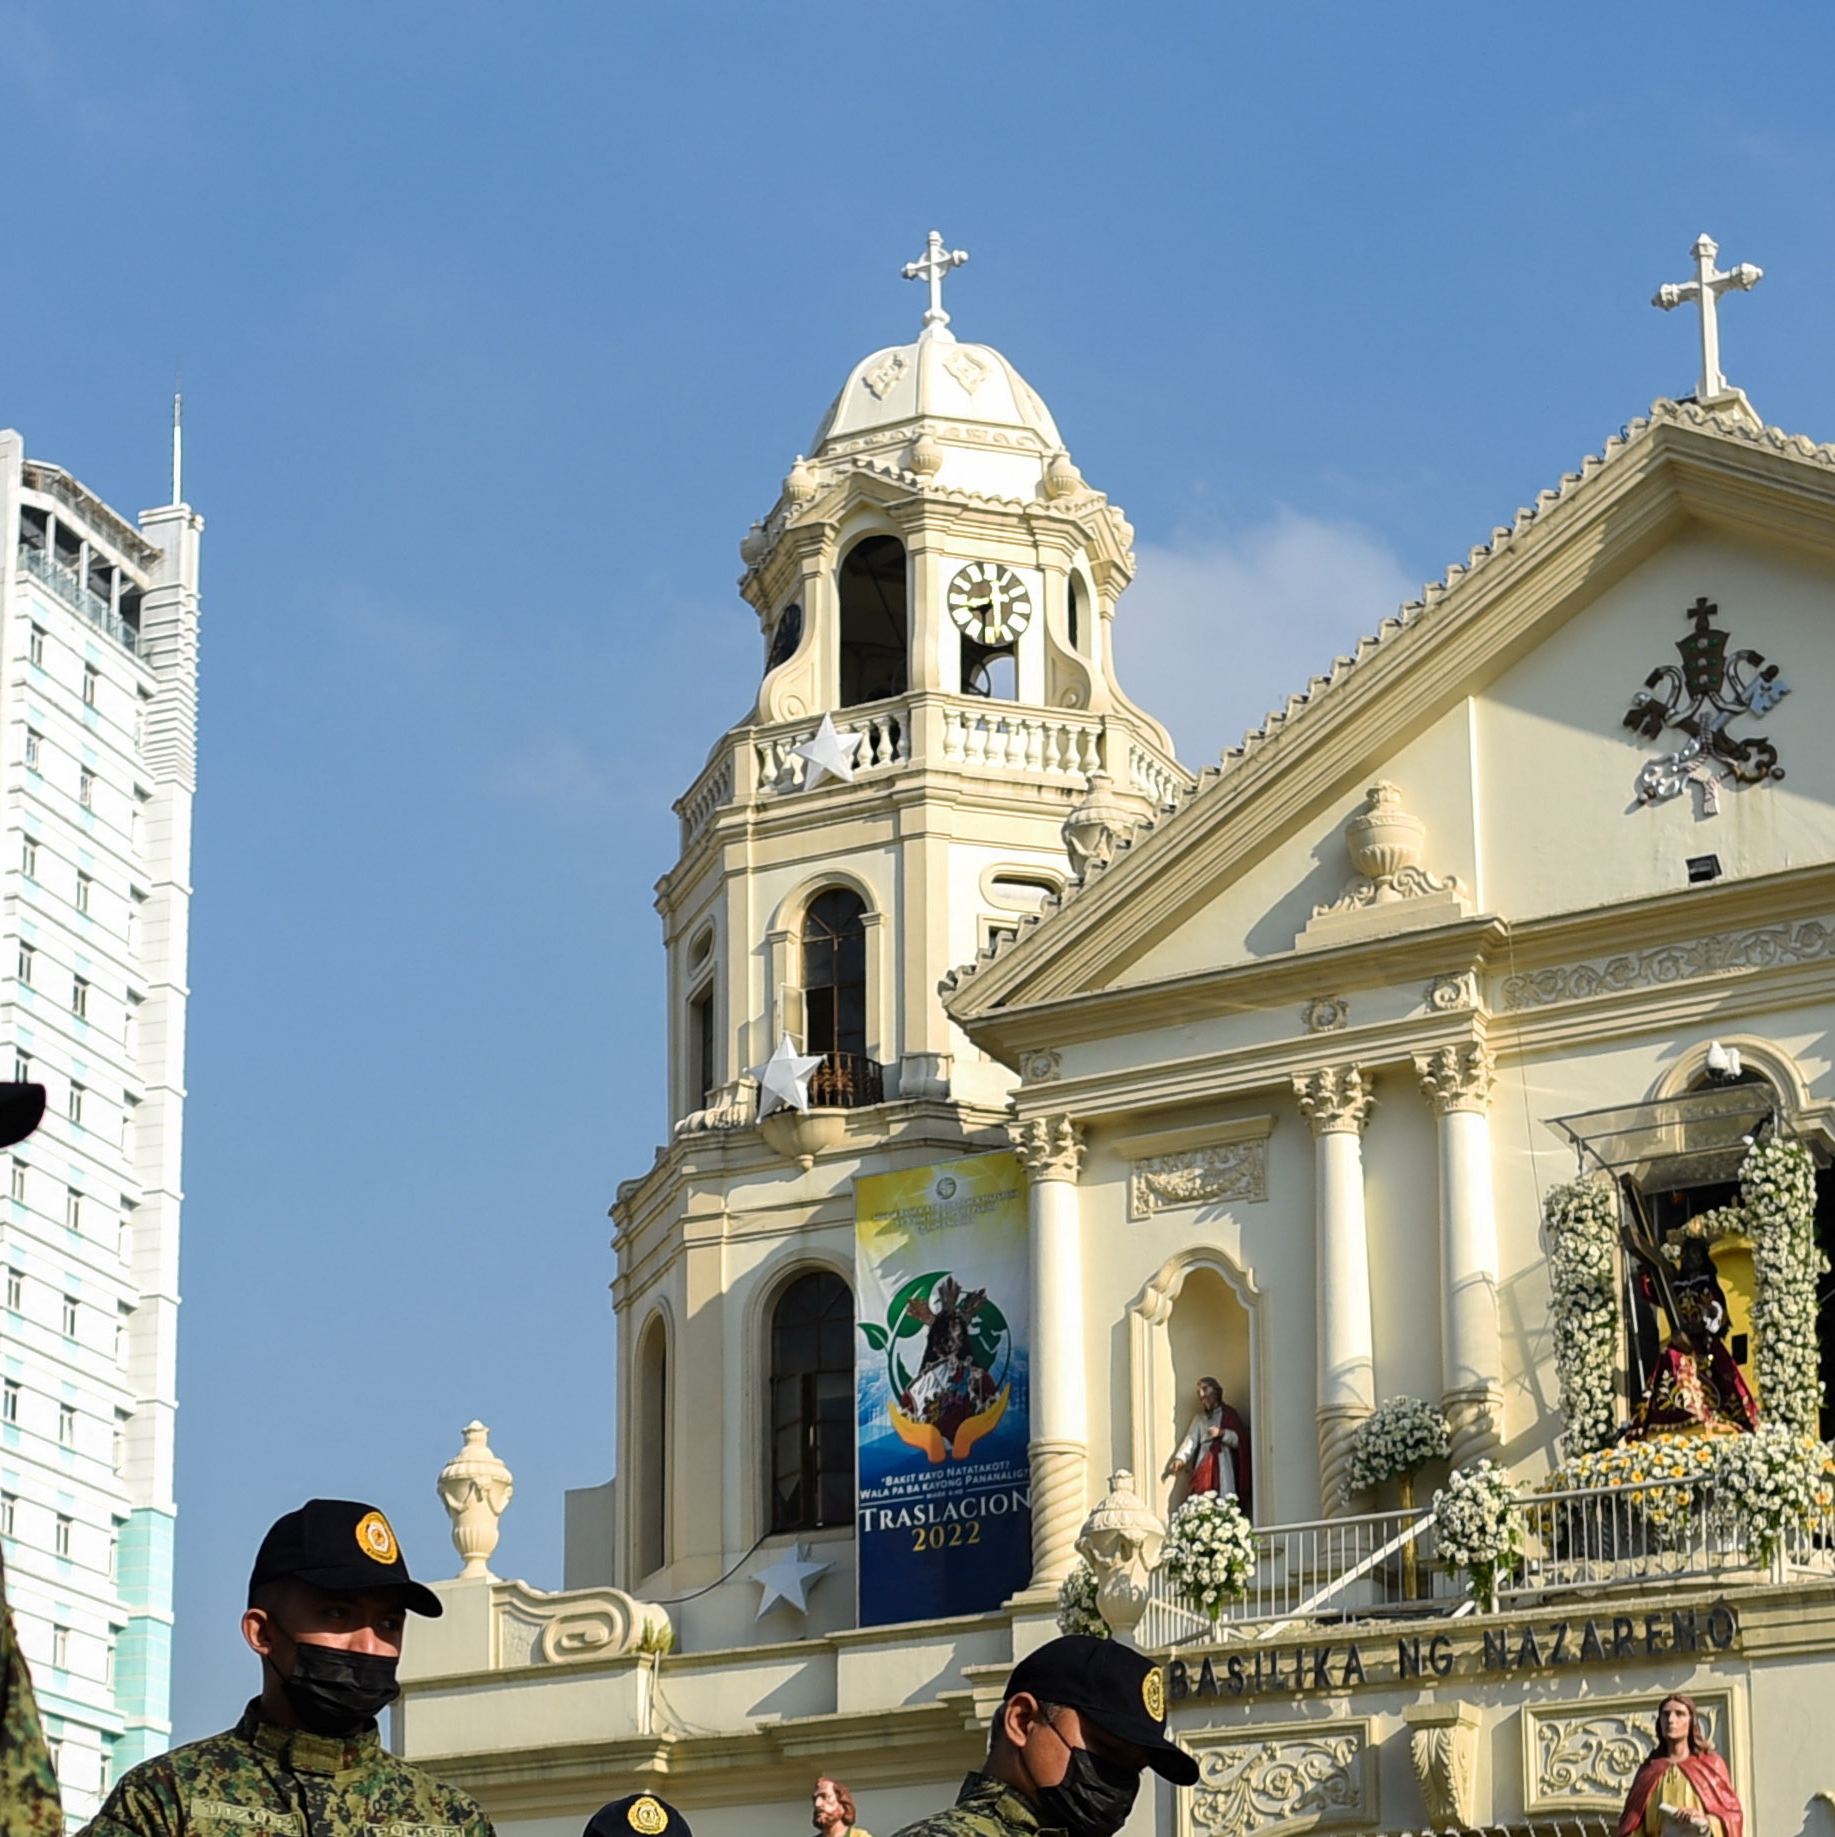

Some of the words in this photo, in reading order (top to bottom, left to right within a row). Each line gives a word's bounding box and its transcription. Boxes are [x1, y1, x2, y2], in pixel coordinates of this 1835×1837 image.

[918, 1468, 944, 1481] KAYO
[946, 1460, 1010, 1477] NATATAKOT?
[860, 1488, 889, 1500] WALA
[892, 1486, 905, 1496] PA
[906, 1484, 920, 1495] BA
[922, 1479, 962, 1492] KAYONG
[859, 1488, 1032, 1532] TRASLACION
[911, 1521, 981, 1552] 2022
[1169, 1643, 1367, 1699] BASILIKA
[1399, 1635, 1454, 1680] NG
[1483, 1606, 1737, 1671] NAZARENO
